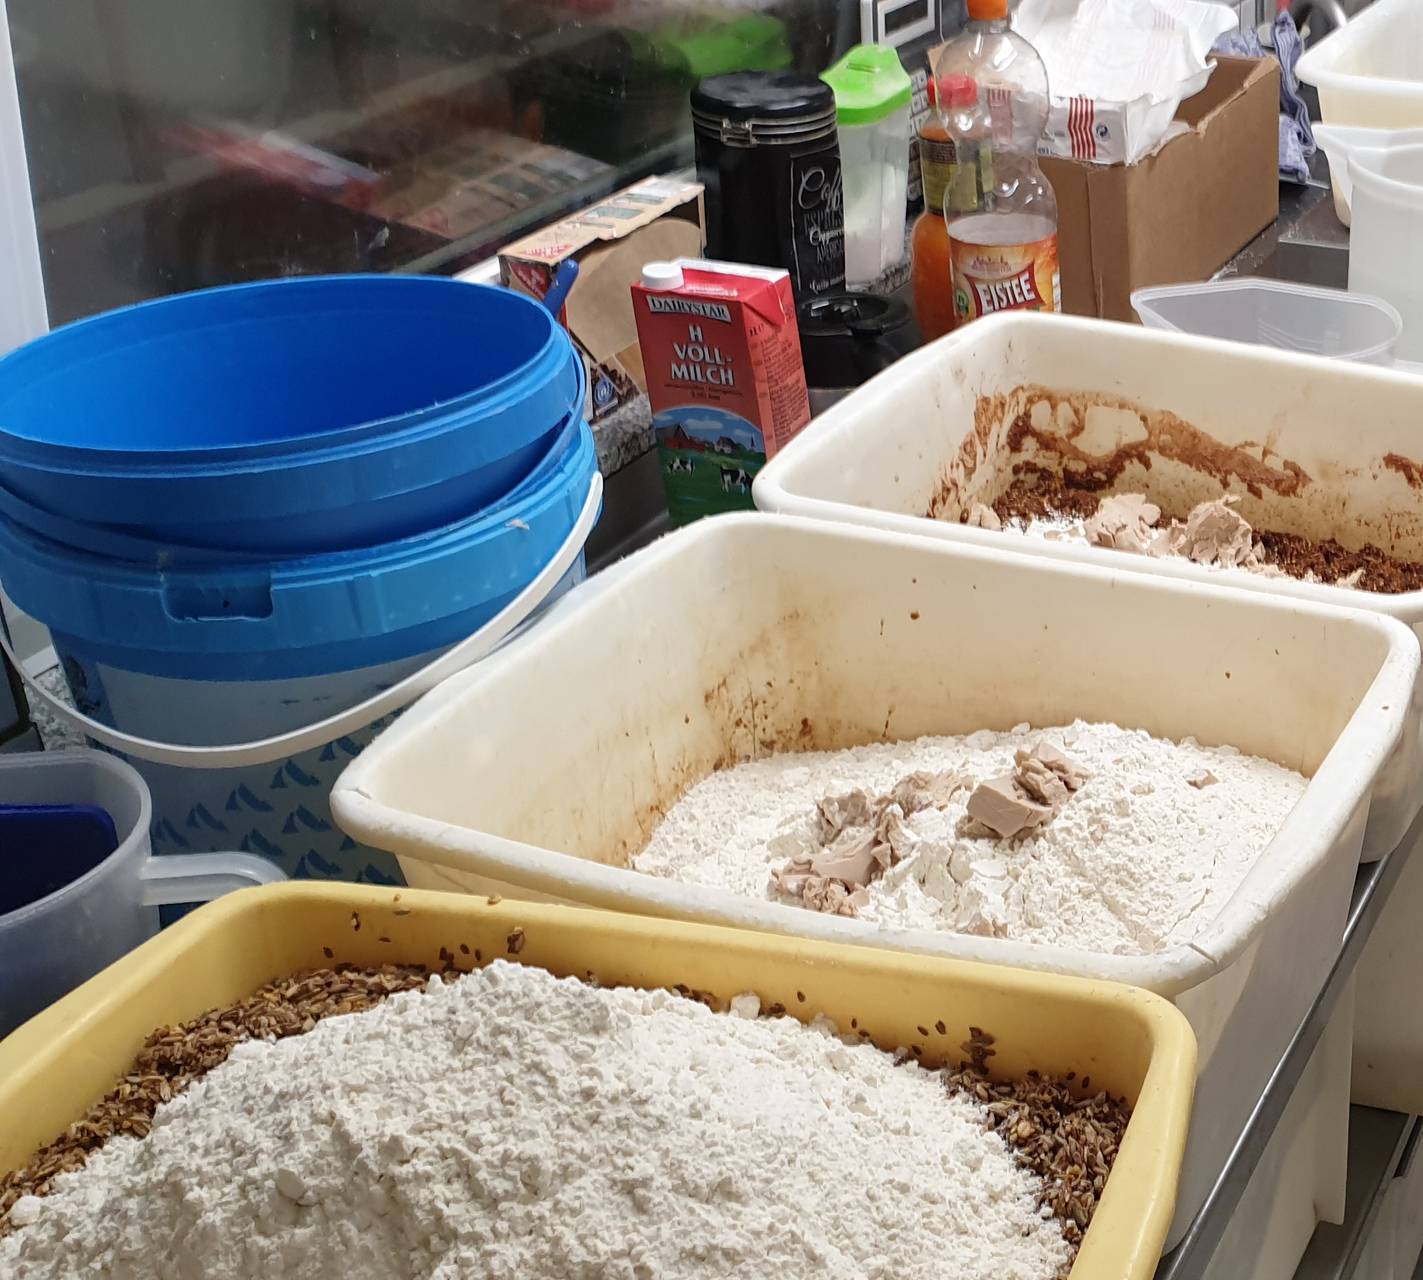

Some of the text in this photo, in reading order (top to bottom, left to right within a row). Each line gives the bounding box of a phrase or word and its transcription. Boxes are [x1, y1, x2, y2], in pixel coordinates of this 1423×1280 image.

[975, 271, 1036, 315] EISTEE
[651, 297, 727, 319] DAIRYSTAR
[689, 324, 704, 342] H
[673, 342, 733, 365] VOLL-
[671, 363, 735, 386] MILCH
